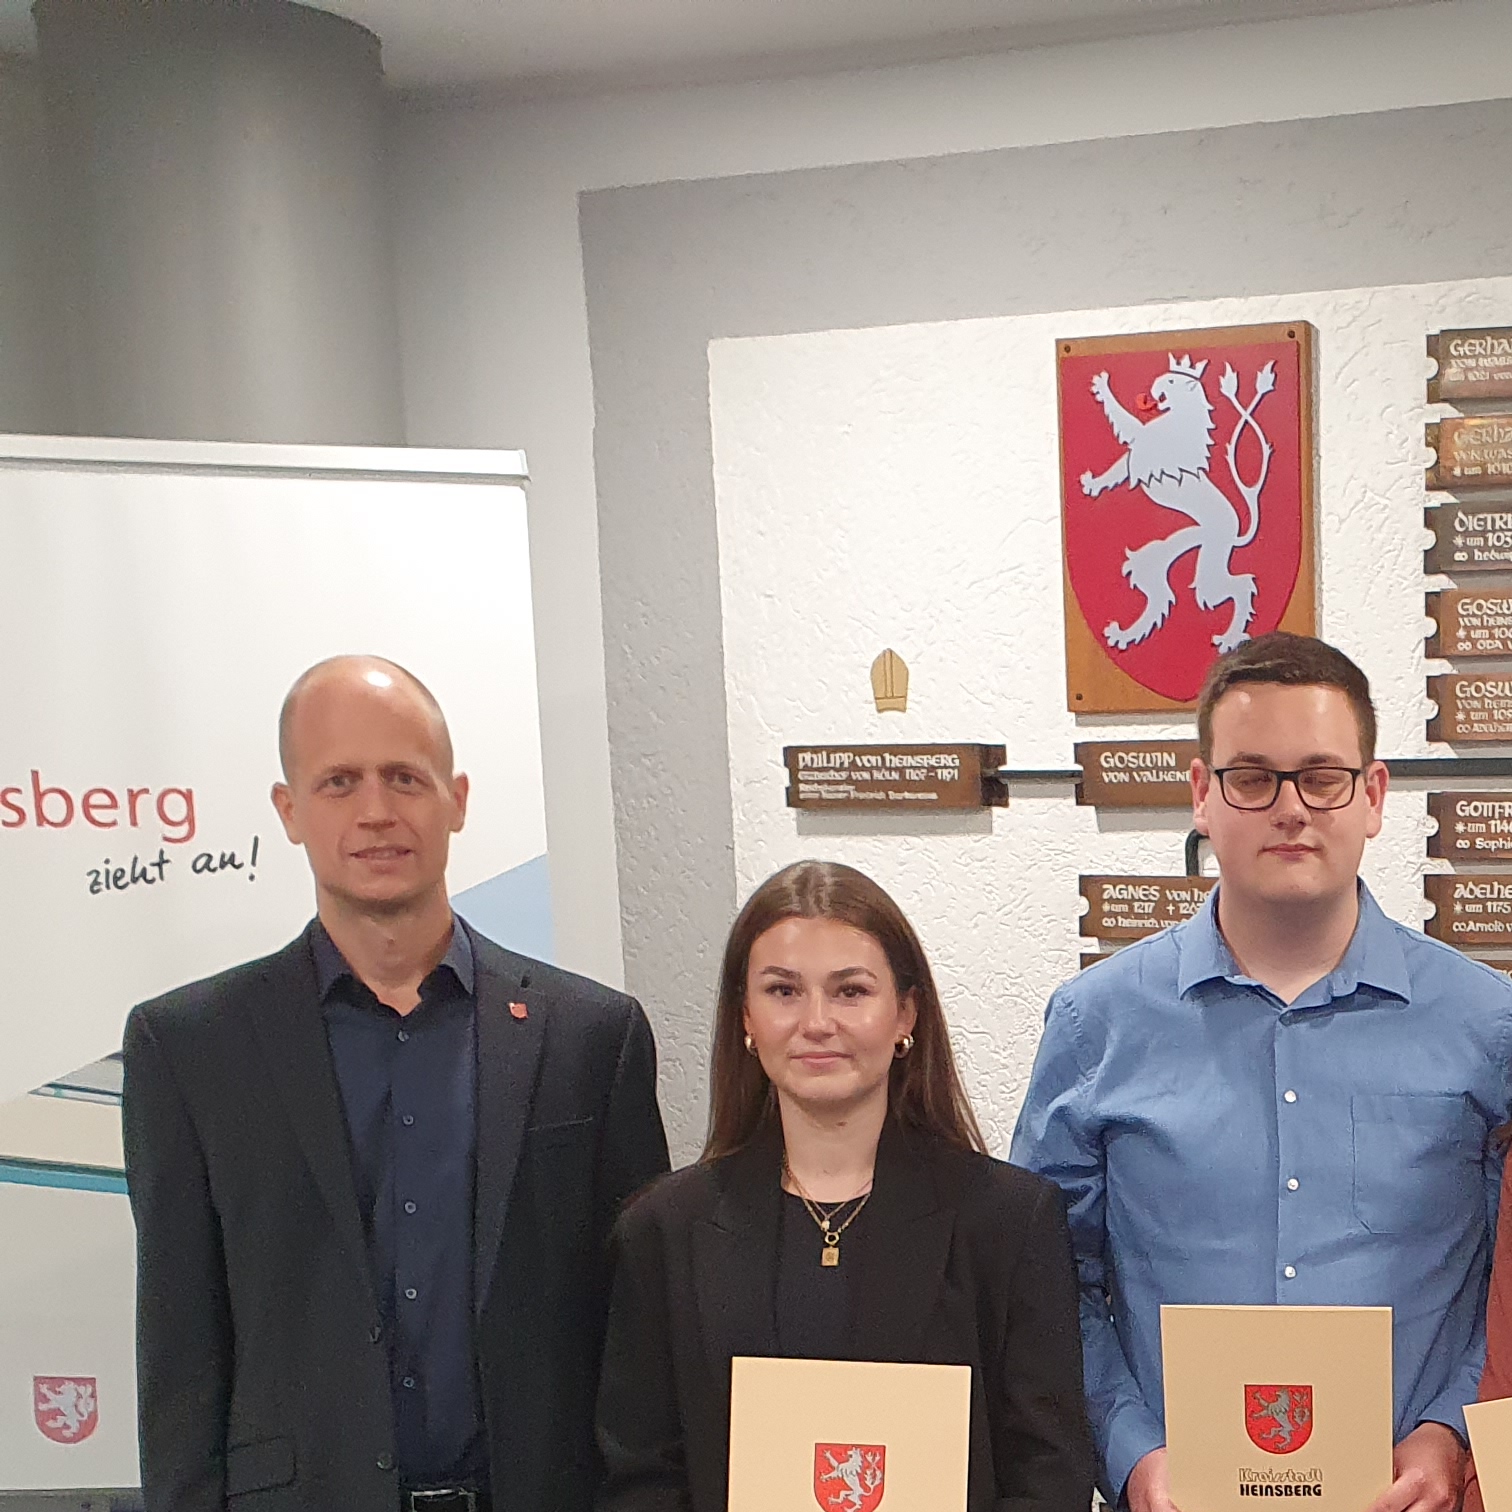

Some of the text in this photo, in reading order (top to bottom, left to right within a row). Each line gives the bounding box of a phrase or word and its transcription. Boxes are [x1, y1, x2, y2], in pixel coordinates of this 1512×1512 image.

[798, 750, 854, 769] PHILIPP
[1100, 751, 1176, 768] GOSWIN
[1102, 771, 1130, 783] VON
[86, 835, 259, 895] zieht an!
[1102, 884, 1160, 900] AGNES
[1239, 1483, 1322, 1497] HEINSBERG
